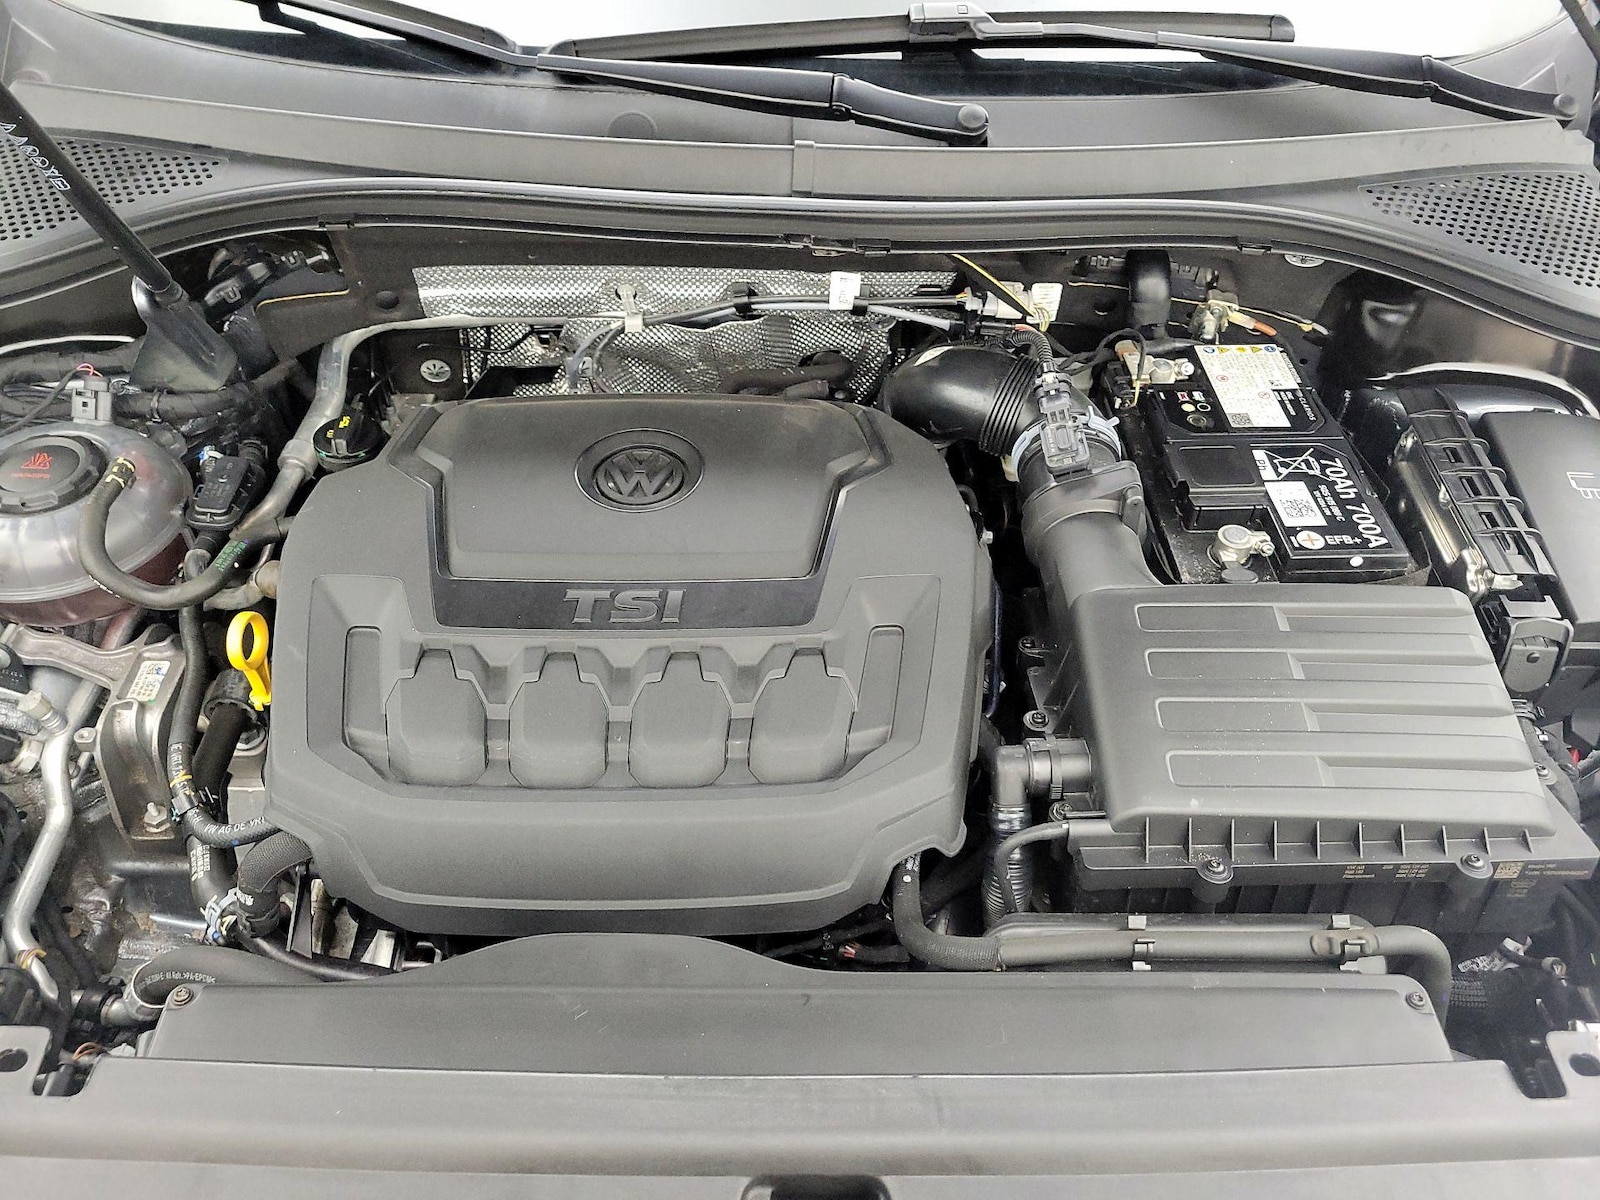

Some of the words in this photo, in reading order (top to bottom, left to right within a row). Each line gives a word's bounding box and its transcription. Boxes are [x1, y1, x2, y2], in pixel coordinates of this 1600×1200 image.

[1319, 457, 1359, 499] 70Ah
[1345, 502, 1389, 549] 700A
[1325, 534, 1363, 545] EFB+
[563, 589, 687, 623] TSI
[204, 823, 218, 835] VW
[218, 825, 231, 835] AG
[233, 822, 246, 832] DE
